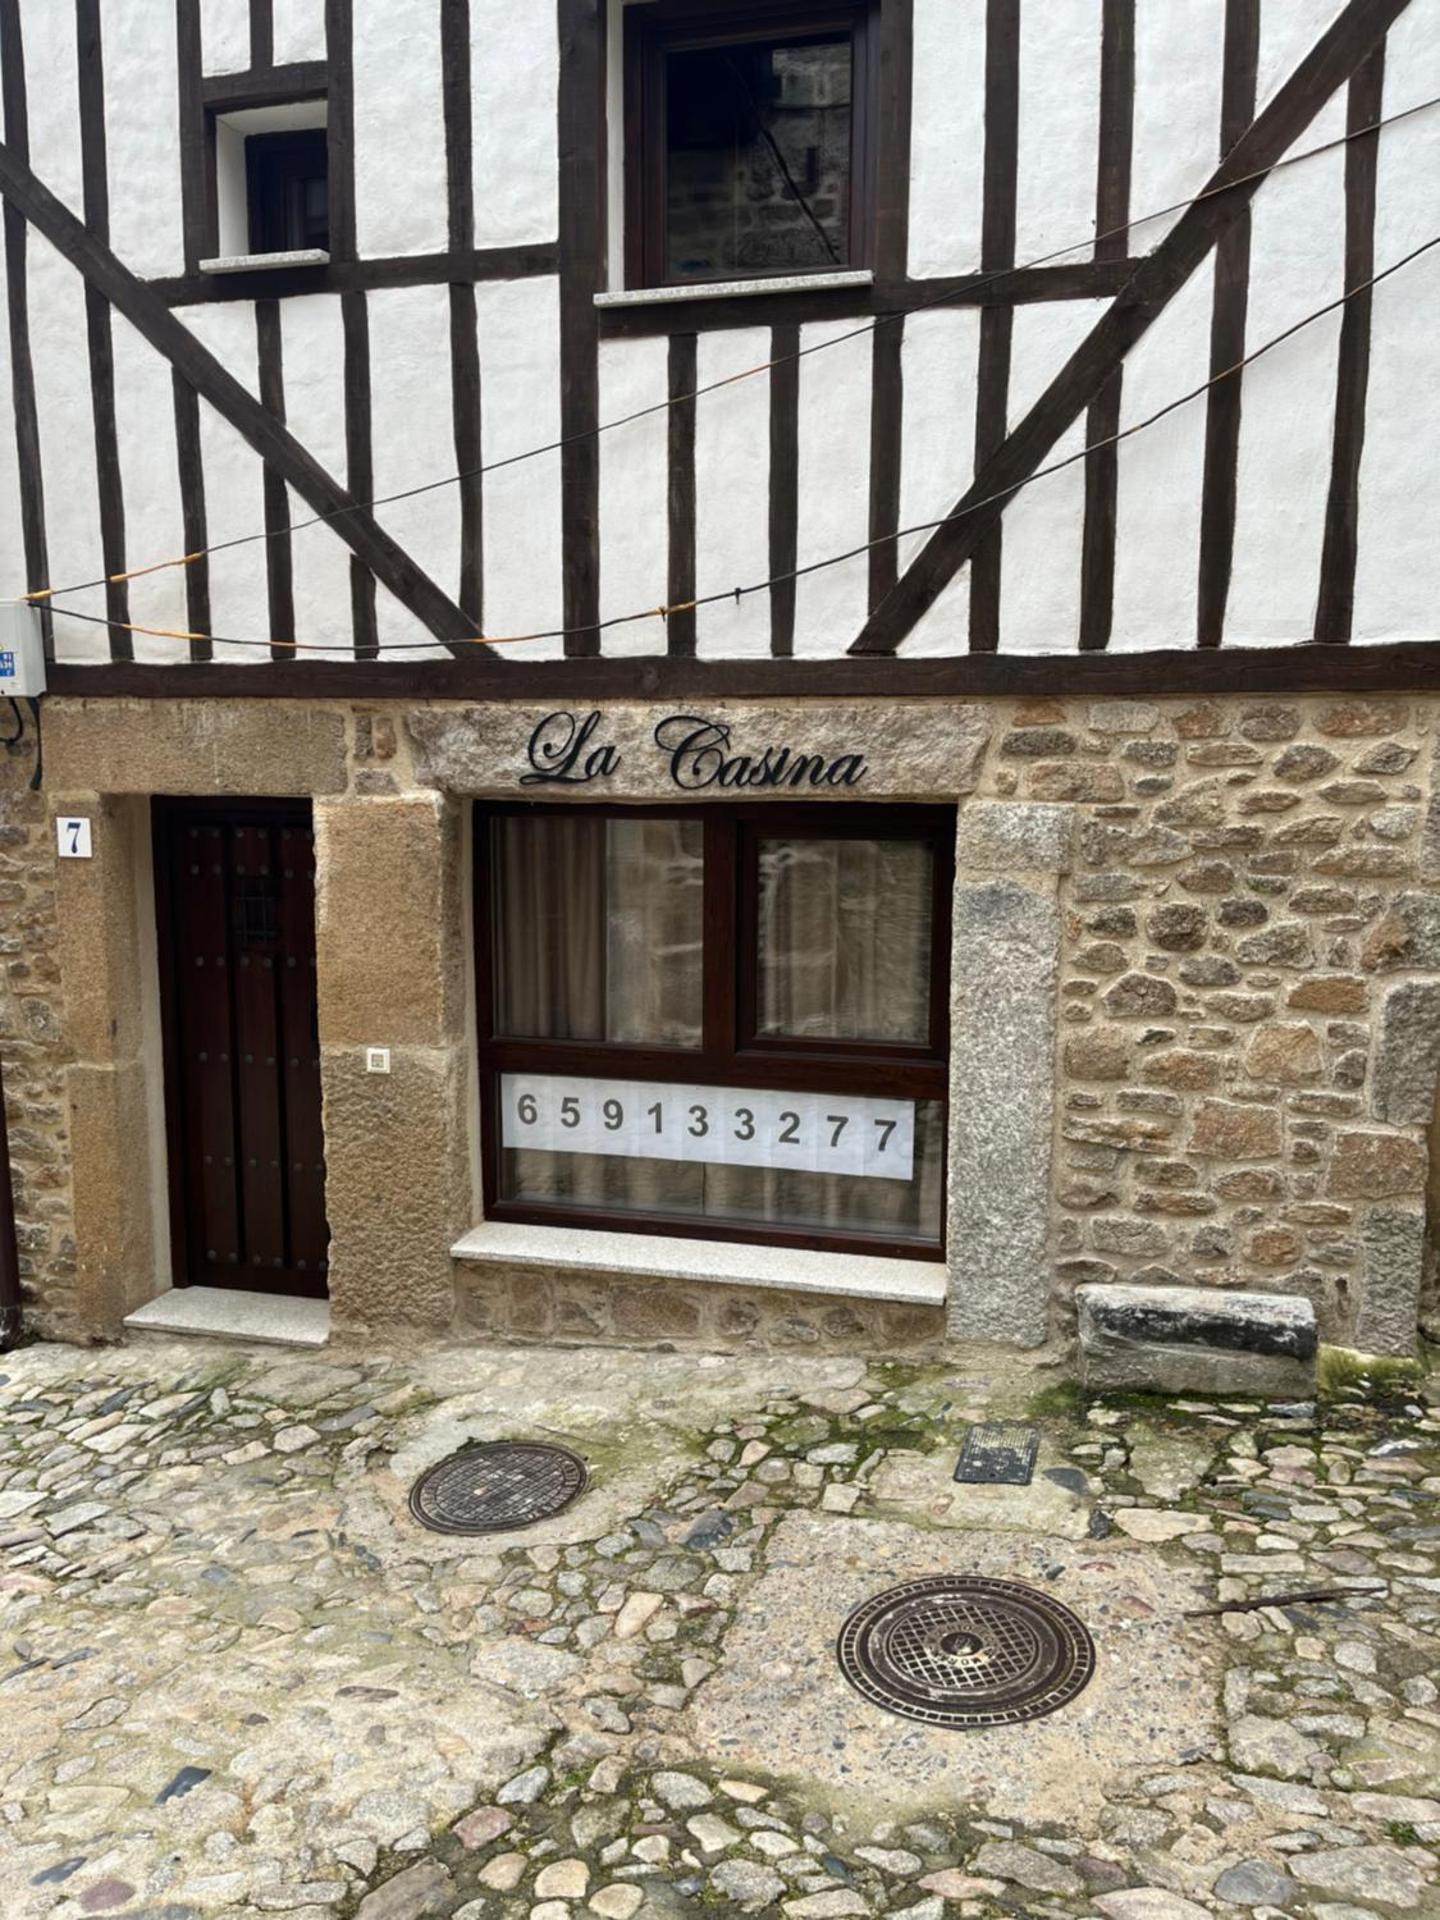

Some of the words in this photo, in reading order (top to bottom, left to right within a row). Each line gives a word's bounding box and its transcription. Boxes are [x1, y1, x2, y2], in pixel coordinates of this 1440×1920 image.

[519, 710, 622, 786] La
[654, 715, 868, 791] Casina
[66, 822, 81, 854] 7
